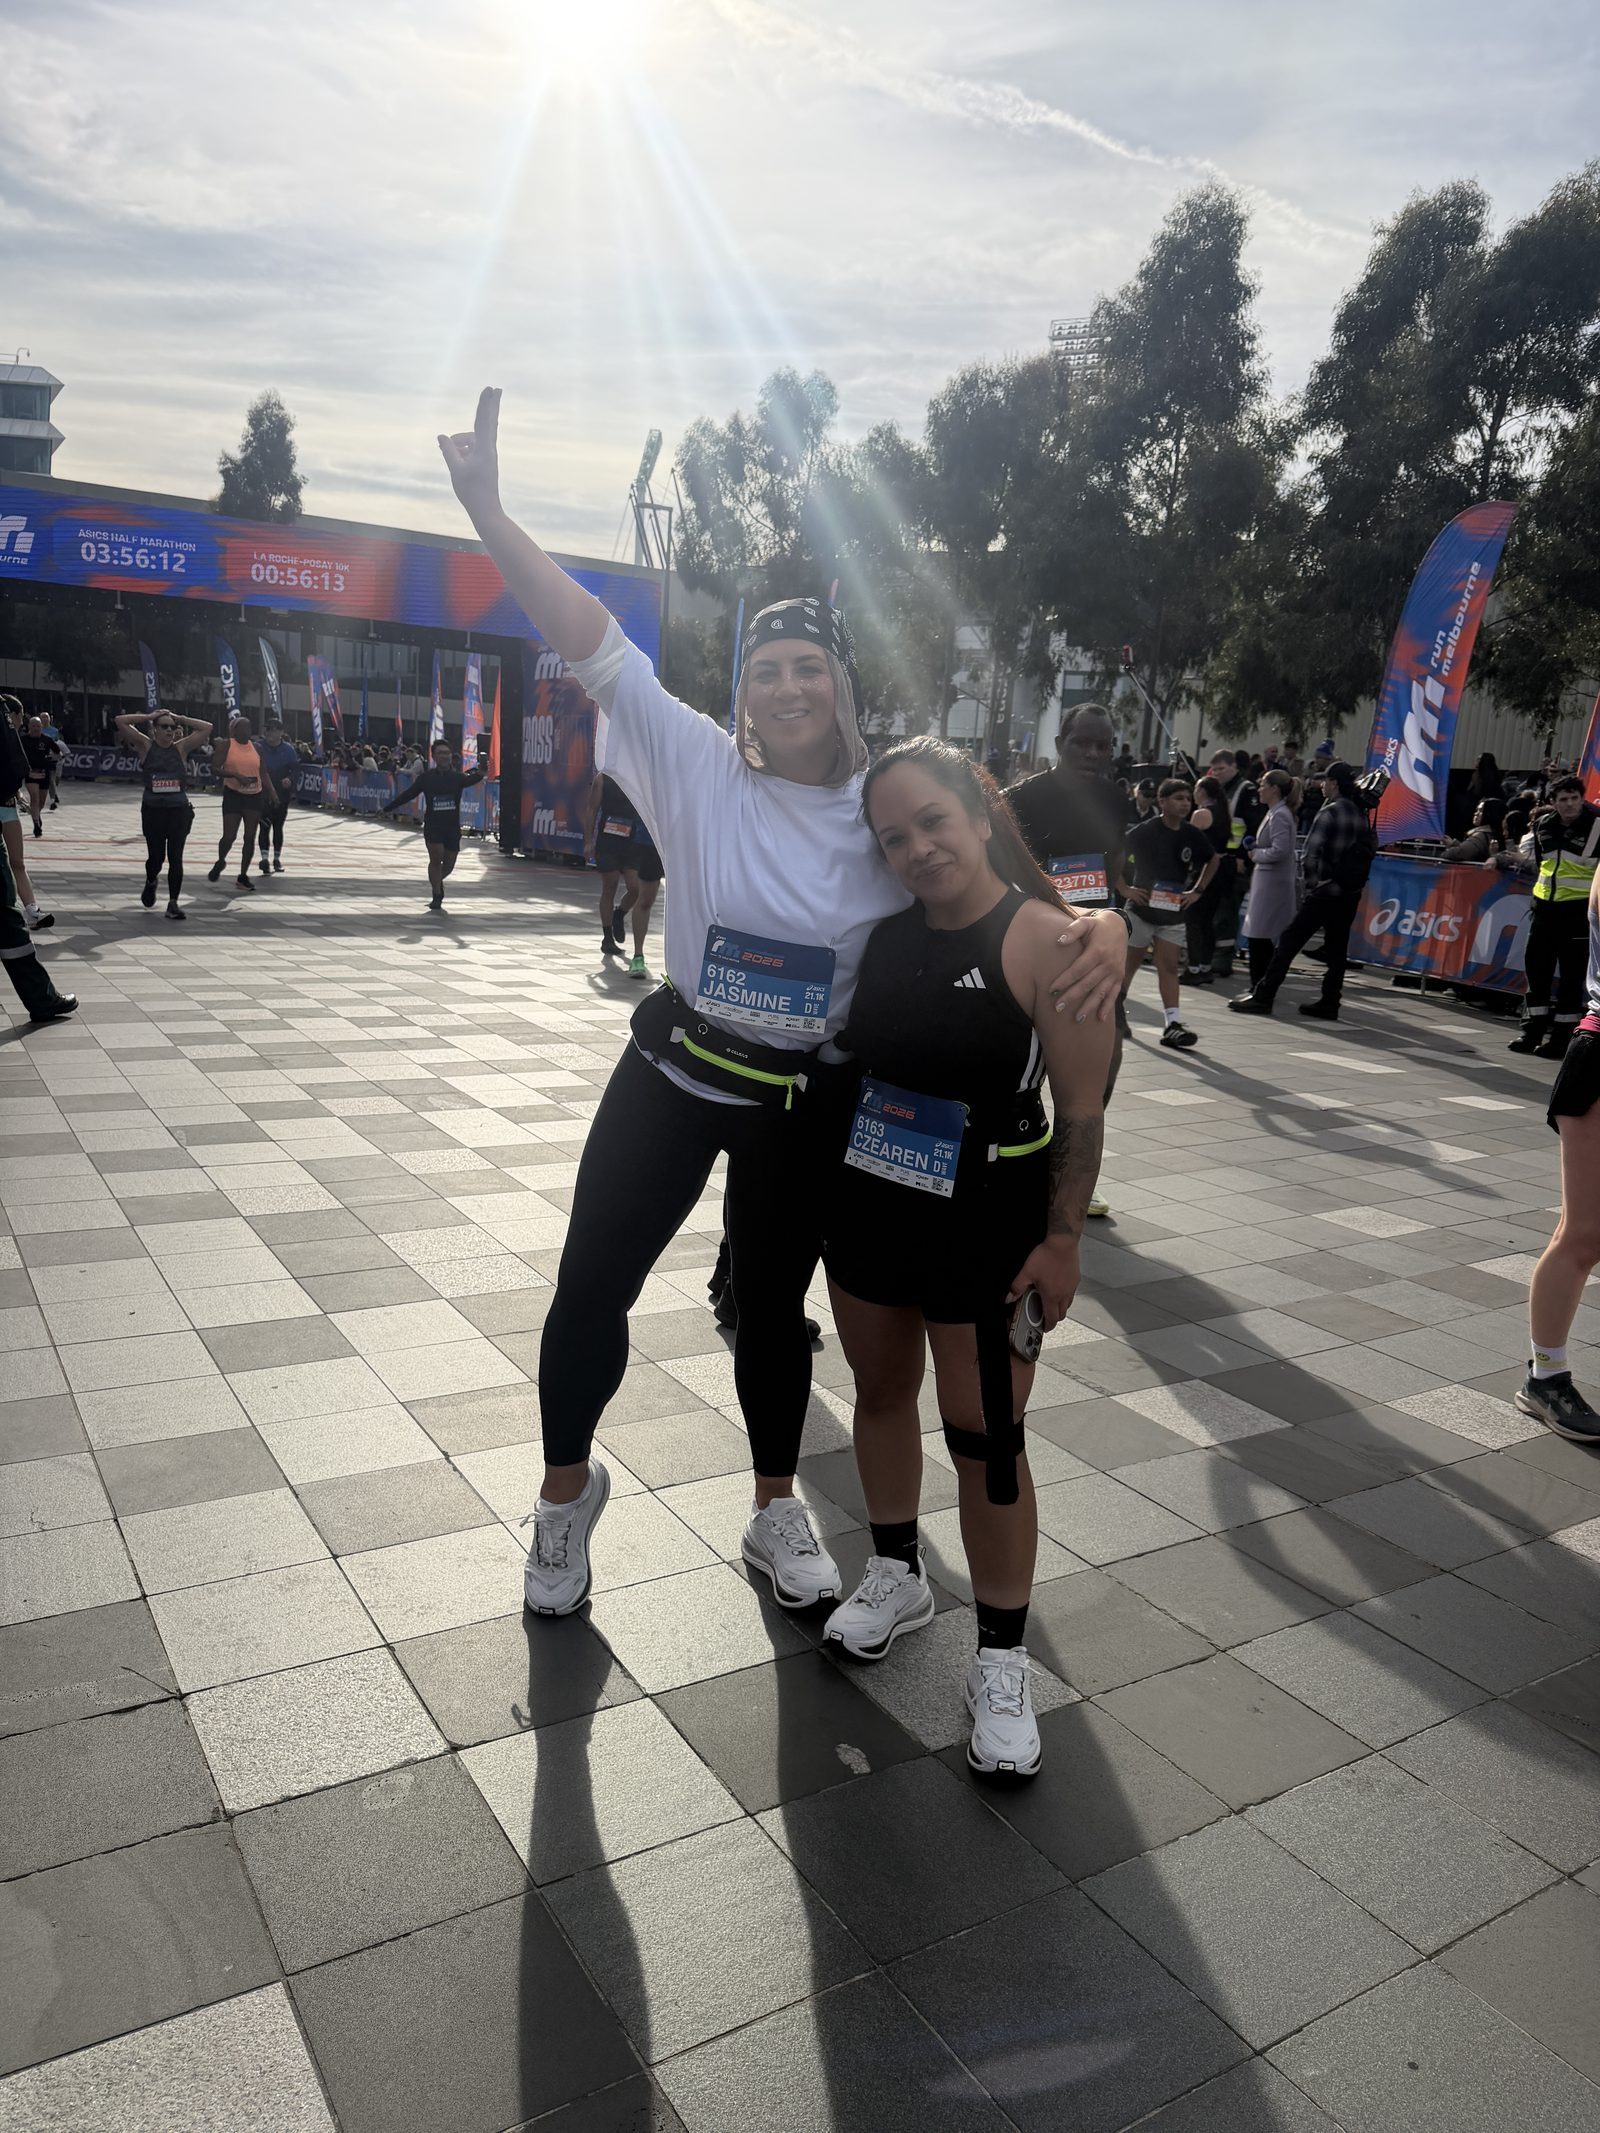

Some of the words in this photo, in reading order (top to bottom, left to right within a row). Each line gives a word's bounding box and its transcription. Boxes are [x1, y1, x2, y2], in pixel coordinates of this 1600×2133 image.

[78, 529, 109, 540] ASICS
[111, 533, 138, 544] HALF
[140, 537, 196, 552] MARATHON
[81, 541, 186, 573] 03:56:12
[254, 551, 266, 561] LA
[268, 553, 333, 570] ROCHE-POSAY
[335, 562, 350, 572] 10K
[251, 563, 345, 592] 00:56:13
[1442, 561, 1481, 677] melbourne
[1430, 630, 1447, 669] run
[742, 951, 785, 968] 2026
[706, 963, 747, 987] 6162
[703, 980, 792, 1012] JASMINE
[804, 991, 825, 1001] 21.1K
[804, 1003, 812, 1014] D
[882, 1103, 916, 1120] 2026
[856, 1115, 885, 1138] 6163
[853, 1131, 929, 1171] CZEAREN
[933, 1148, 953, 1160] 21.1K
[933, 1160, 941, 1173] D
